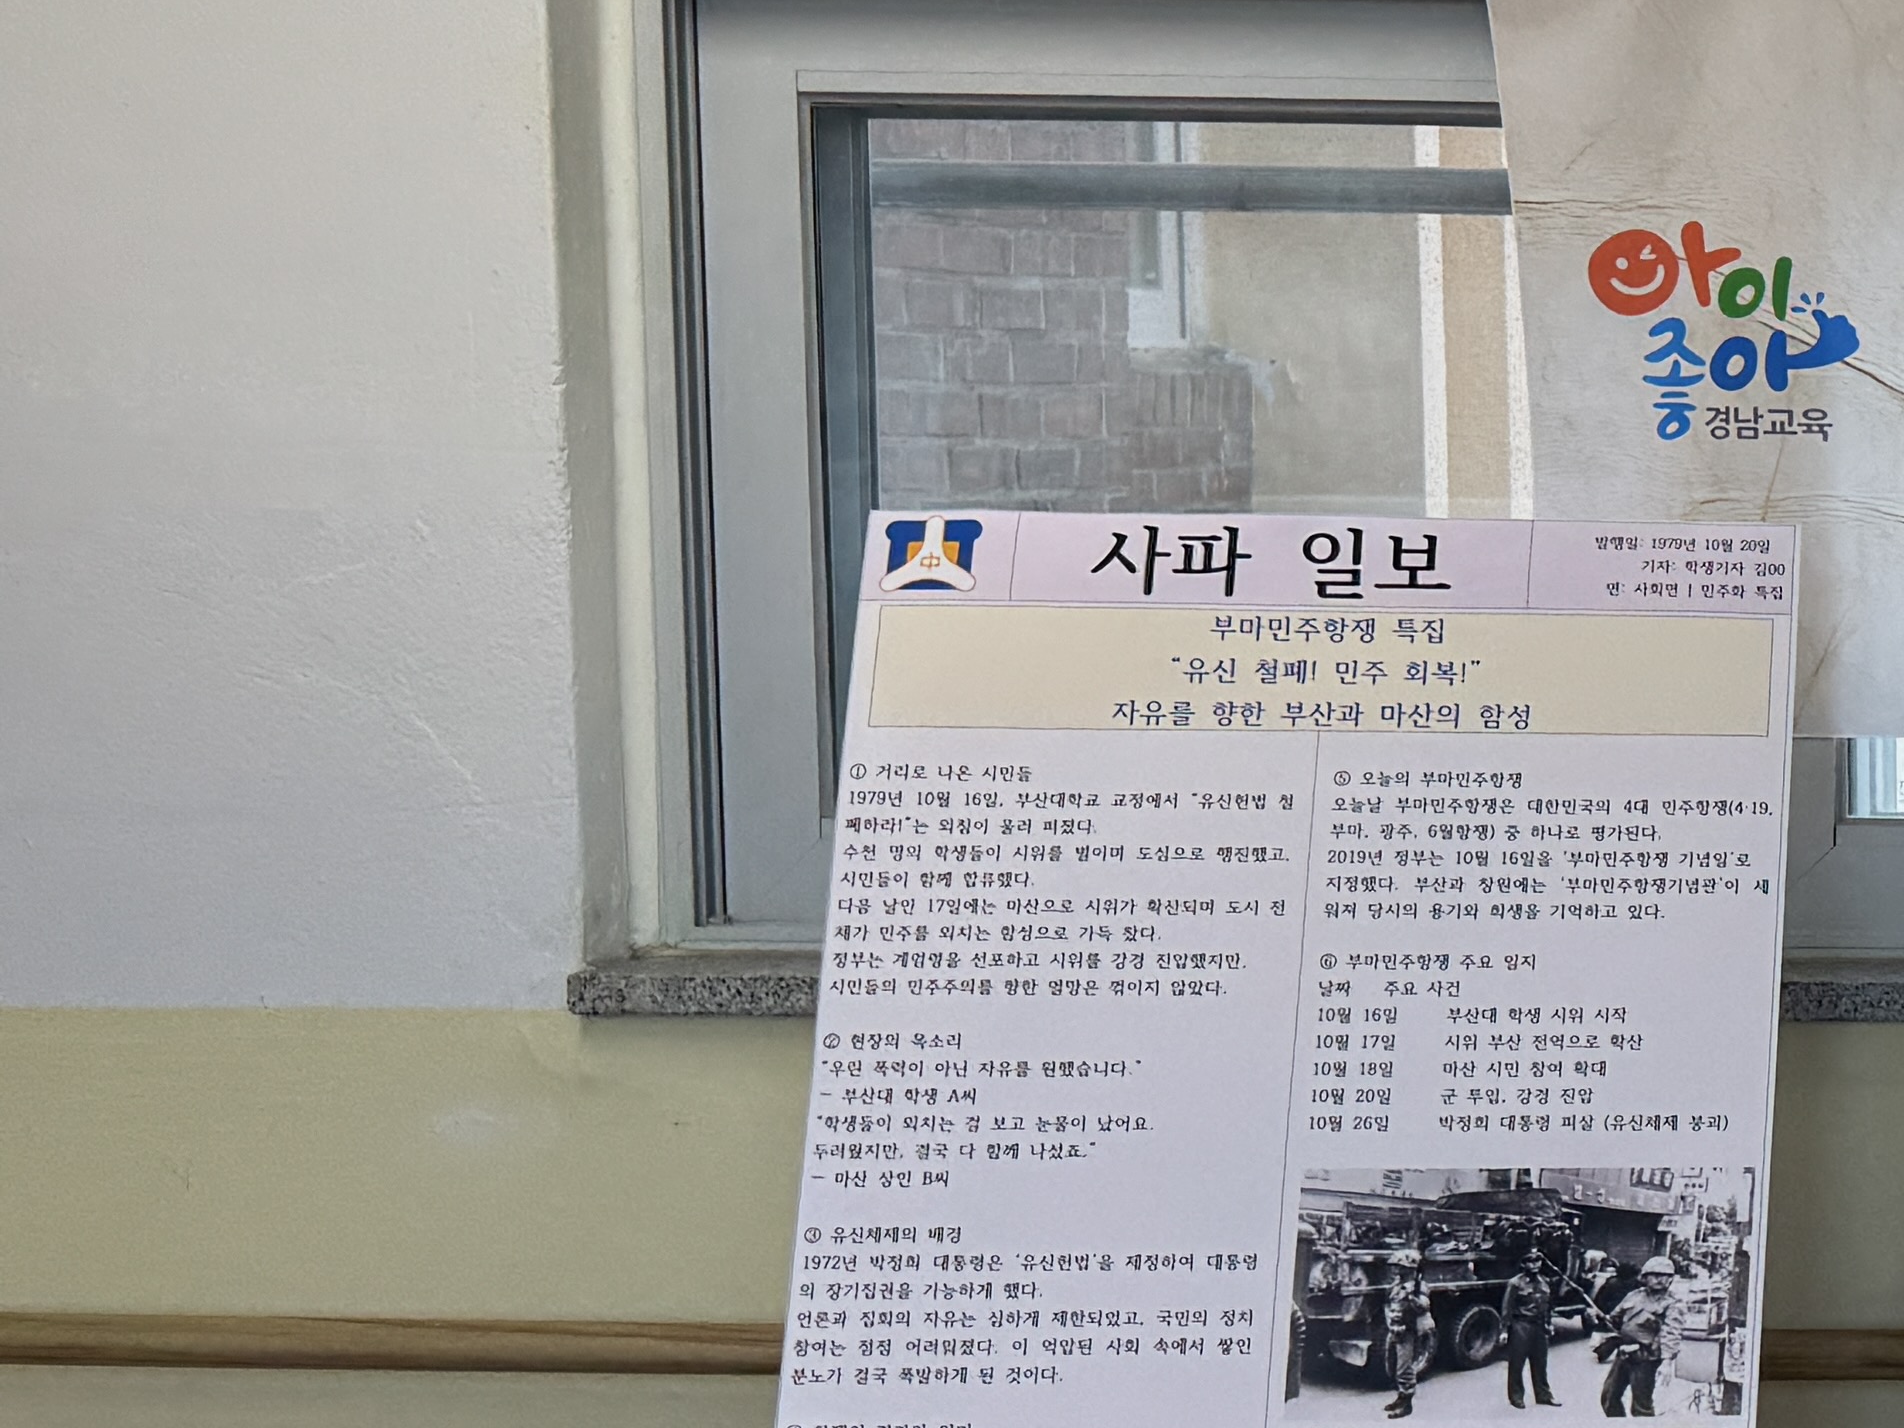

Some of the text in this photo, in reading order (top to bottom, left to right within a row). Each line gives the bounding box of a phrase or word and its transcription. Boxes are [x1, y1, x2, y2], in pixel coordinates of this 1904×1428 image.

[1588, 221, 1791, 318] 아이
[1643, 308, 1858, 443] 좋아
[1704, 405, 1834, 443] 경남교육
[1651, 537, 1697, 553] 1979년
[1705, 538, 1734, 554] 10월
[1739, 538, 1771, 555] 20일
[1089, 524, 1453, 600] 사파 일보
[1209, 614, 1444, 645] 부마민주항쟁 특집
[1254, 657, 1318, 685] 철폐!
[1335, 659, 1389, 687] 민주
[1111, 699, 1531, 731] 자유를 향한 부산과 마산의 함성
[875, 762, 928, 782] 거리로
[937, 764, 974, 783] 나온
[981, 764, 1033, 783] 시민들
[1359, 770, 1410, 788] 오늘의
[1419, 770, 1523, 790] 부마민주항쟁
[849, 789, 1179, 810] 1979년 10월 부산대학교 교정에서
[1330, 795, 1611, 816] 오늘날 부마민주항쟁은 대한민국의
[842, 843, 877, 862] 수천
[1012, 844, 1063, 863] 시위를
[1327, 849, 1383, 867] 2019년
[1393, 848, 1445, 868] 정부는
[1456, 849, 1489, 868] 10월
[1413, 875, 1467, 894] 부산과
[1006, 897, 1259, 917] 마산으로 도시
[1367, 901, 1666, 921] 당시의 기억하고 있다.
[832, 950, 1145, 971] 정부는 선포하고 강경
[1345, 952, 1494, 972] 부마민주항쟁 주요
[829, 977, 897, 996] 시민들의
[1318, 979, 1461, 998] 날짜 주요 사건
[1317, 1005, 1627, 1026] 10월 16일 부산대 학생 시위 시작
[1315, 1033, 1350, 1052] 10월
[1360, 1033, 1396, 1052] 17일
[1444, 1033, 1478, 1052] 시위
[1487, 1033, 1522, 1052] 부산
[1312, 1059, 1520, 1079] 10월 18일 마산 시민
[841, 1085, 894, 1107] 부산대
[904, 1086, 938, 1106] 학생
[1311, 1087, 1595, 1106] 10월 20일 군 진압
[1309, 1114, 1343, 1133] 10월
[1352, 1114, 1389, 1133] 26일
[1499, 1114, 1551, 1133] 대통령
[1559, 1113, 1596, 1132] 피살
[834, 1169, 868, 1189] 마산
[803, 1253, 858, 1273] 1972년
[923, 1308, 1254, 1330] 자유는 국민의 정치
